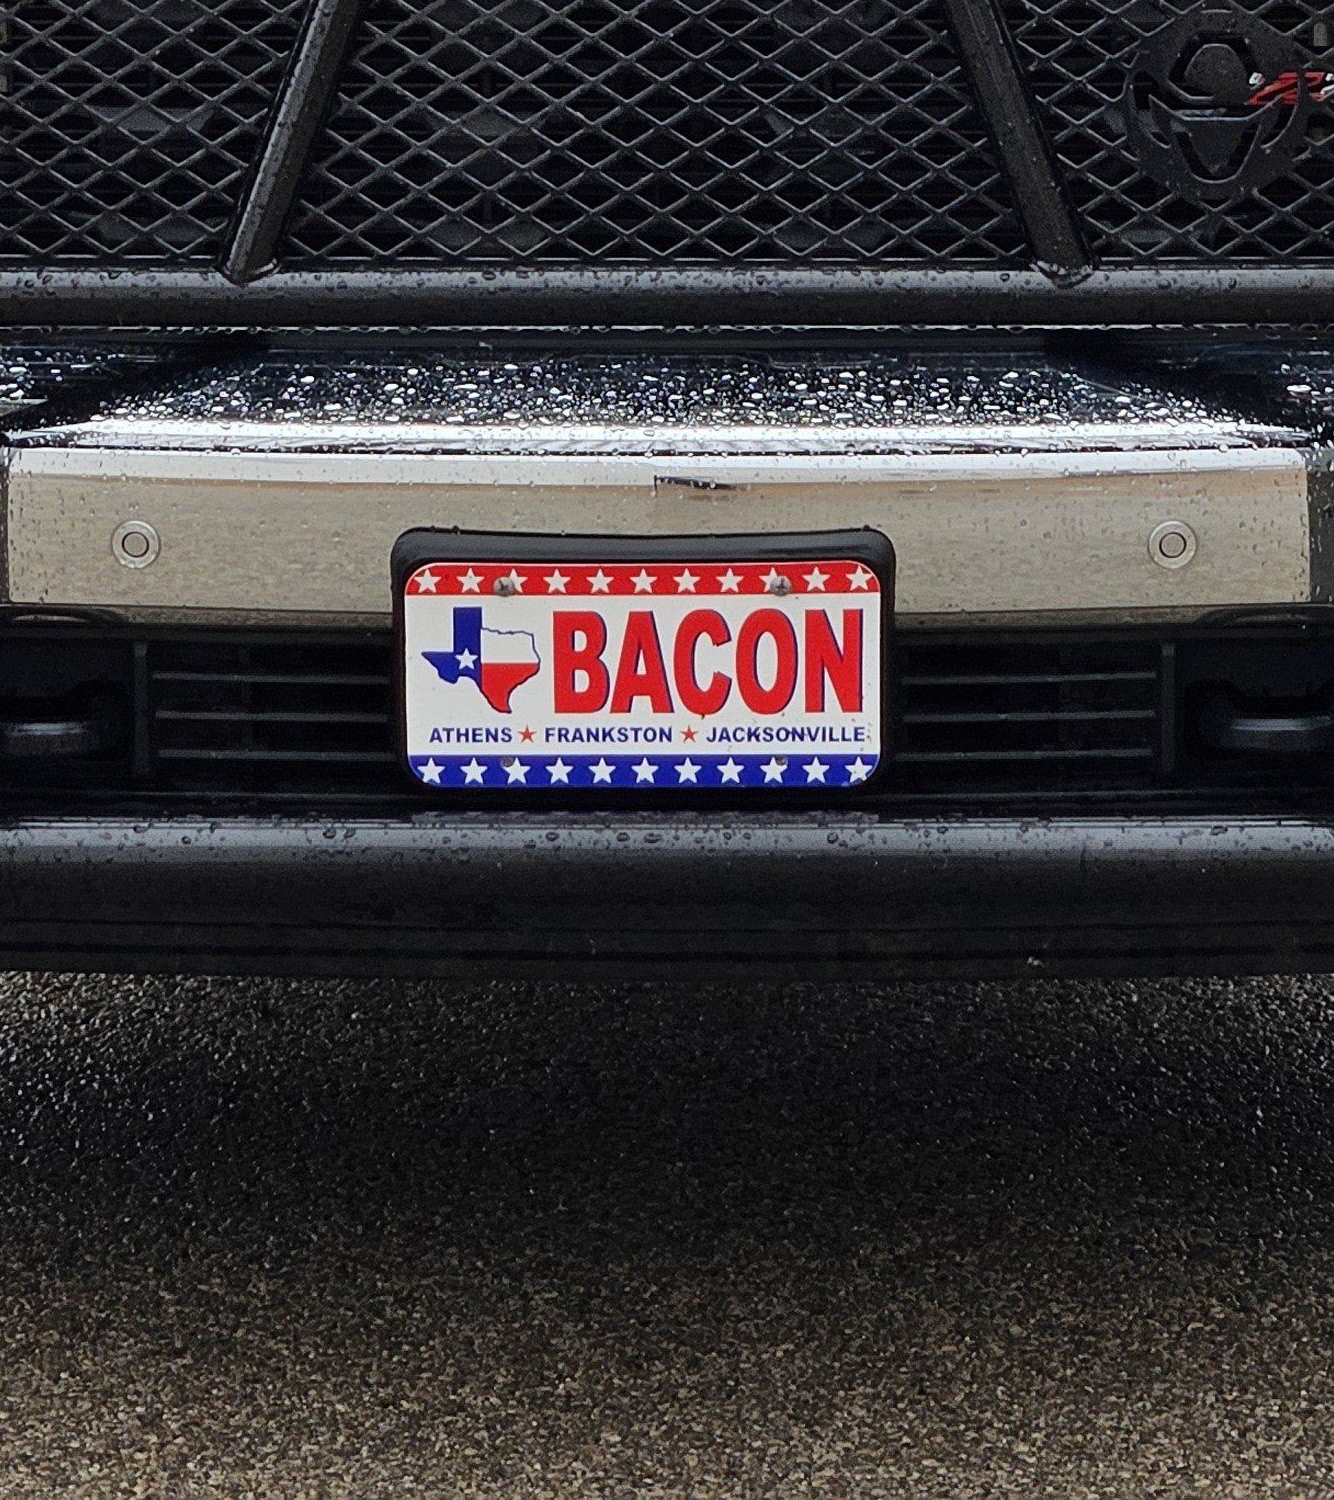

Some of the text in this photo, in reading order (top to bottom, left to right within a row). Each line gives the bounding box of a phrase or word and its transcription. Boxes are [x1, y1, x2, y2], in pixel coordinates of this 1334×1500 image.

[551, 607, 865, 717] BACON
[429, 725, 866, 744] ATHENS FRANKSTON JACKSONVILLE
